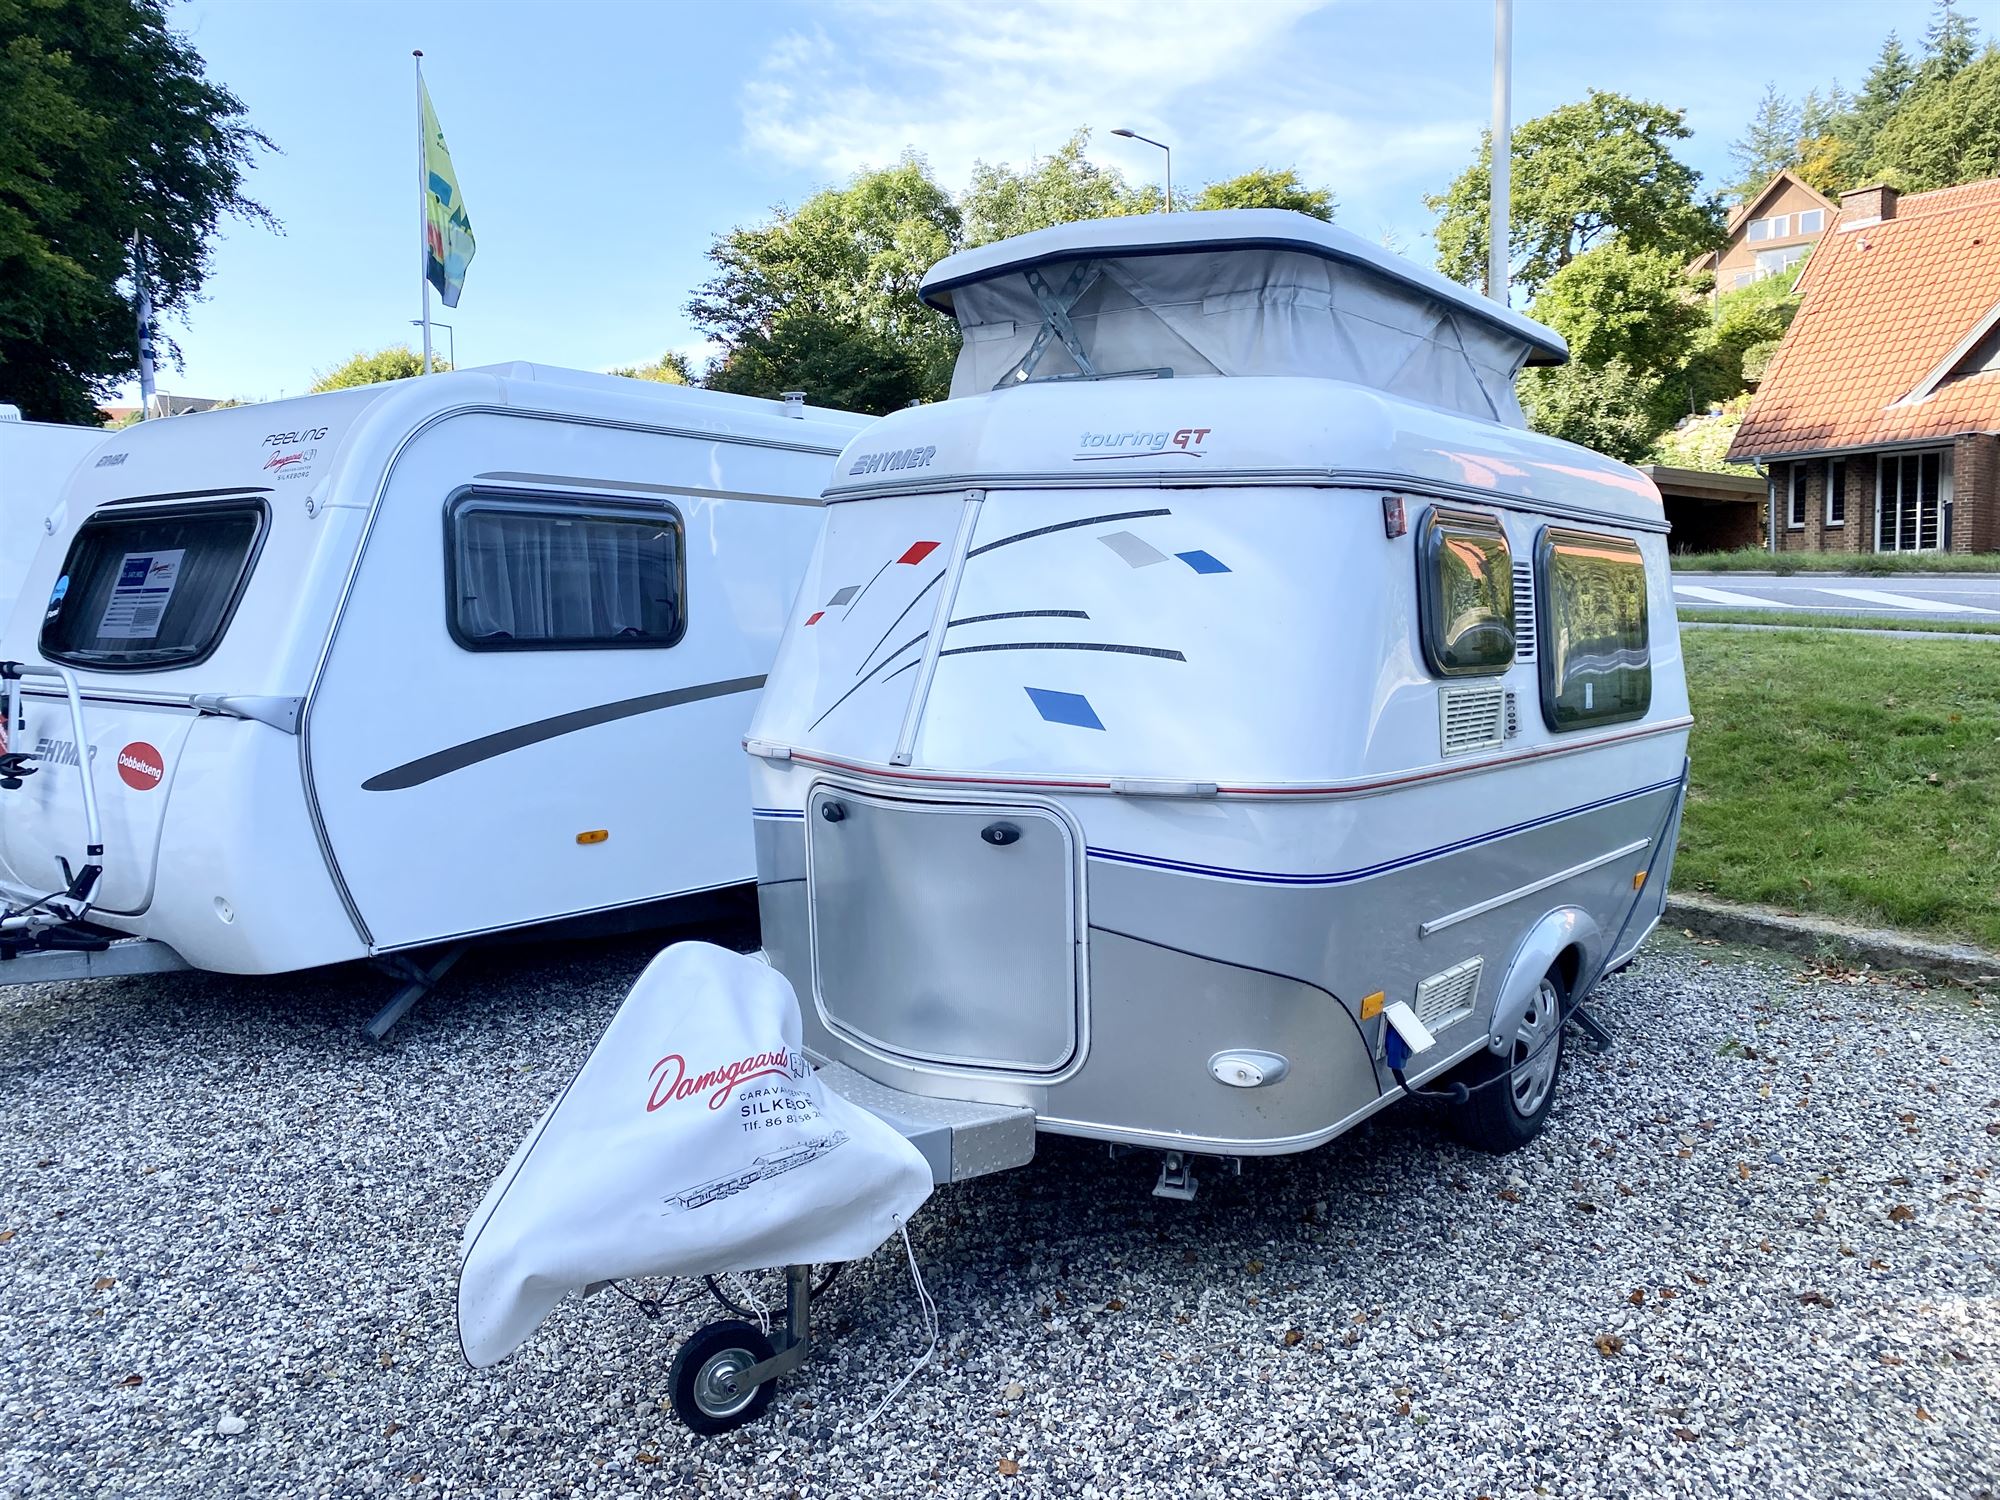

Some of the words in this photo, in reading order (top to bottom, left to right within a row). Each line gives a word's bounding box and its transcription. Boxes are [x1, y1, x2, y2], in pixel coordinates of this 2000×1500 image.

[261, 427, 329, 447] FEELING
[1080, 431, 1170, 450] touring
[1172, 428, 1211, 449] GT
[865, 445, 937, 474] HYMER
[43, 739, 98, 766] HYMR
[118, 753, 162, 781] Dobbeltseng
[646, 1046, 792, 1112] Damsgaards
[765, 1116, 782, 1128] 86
